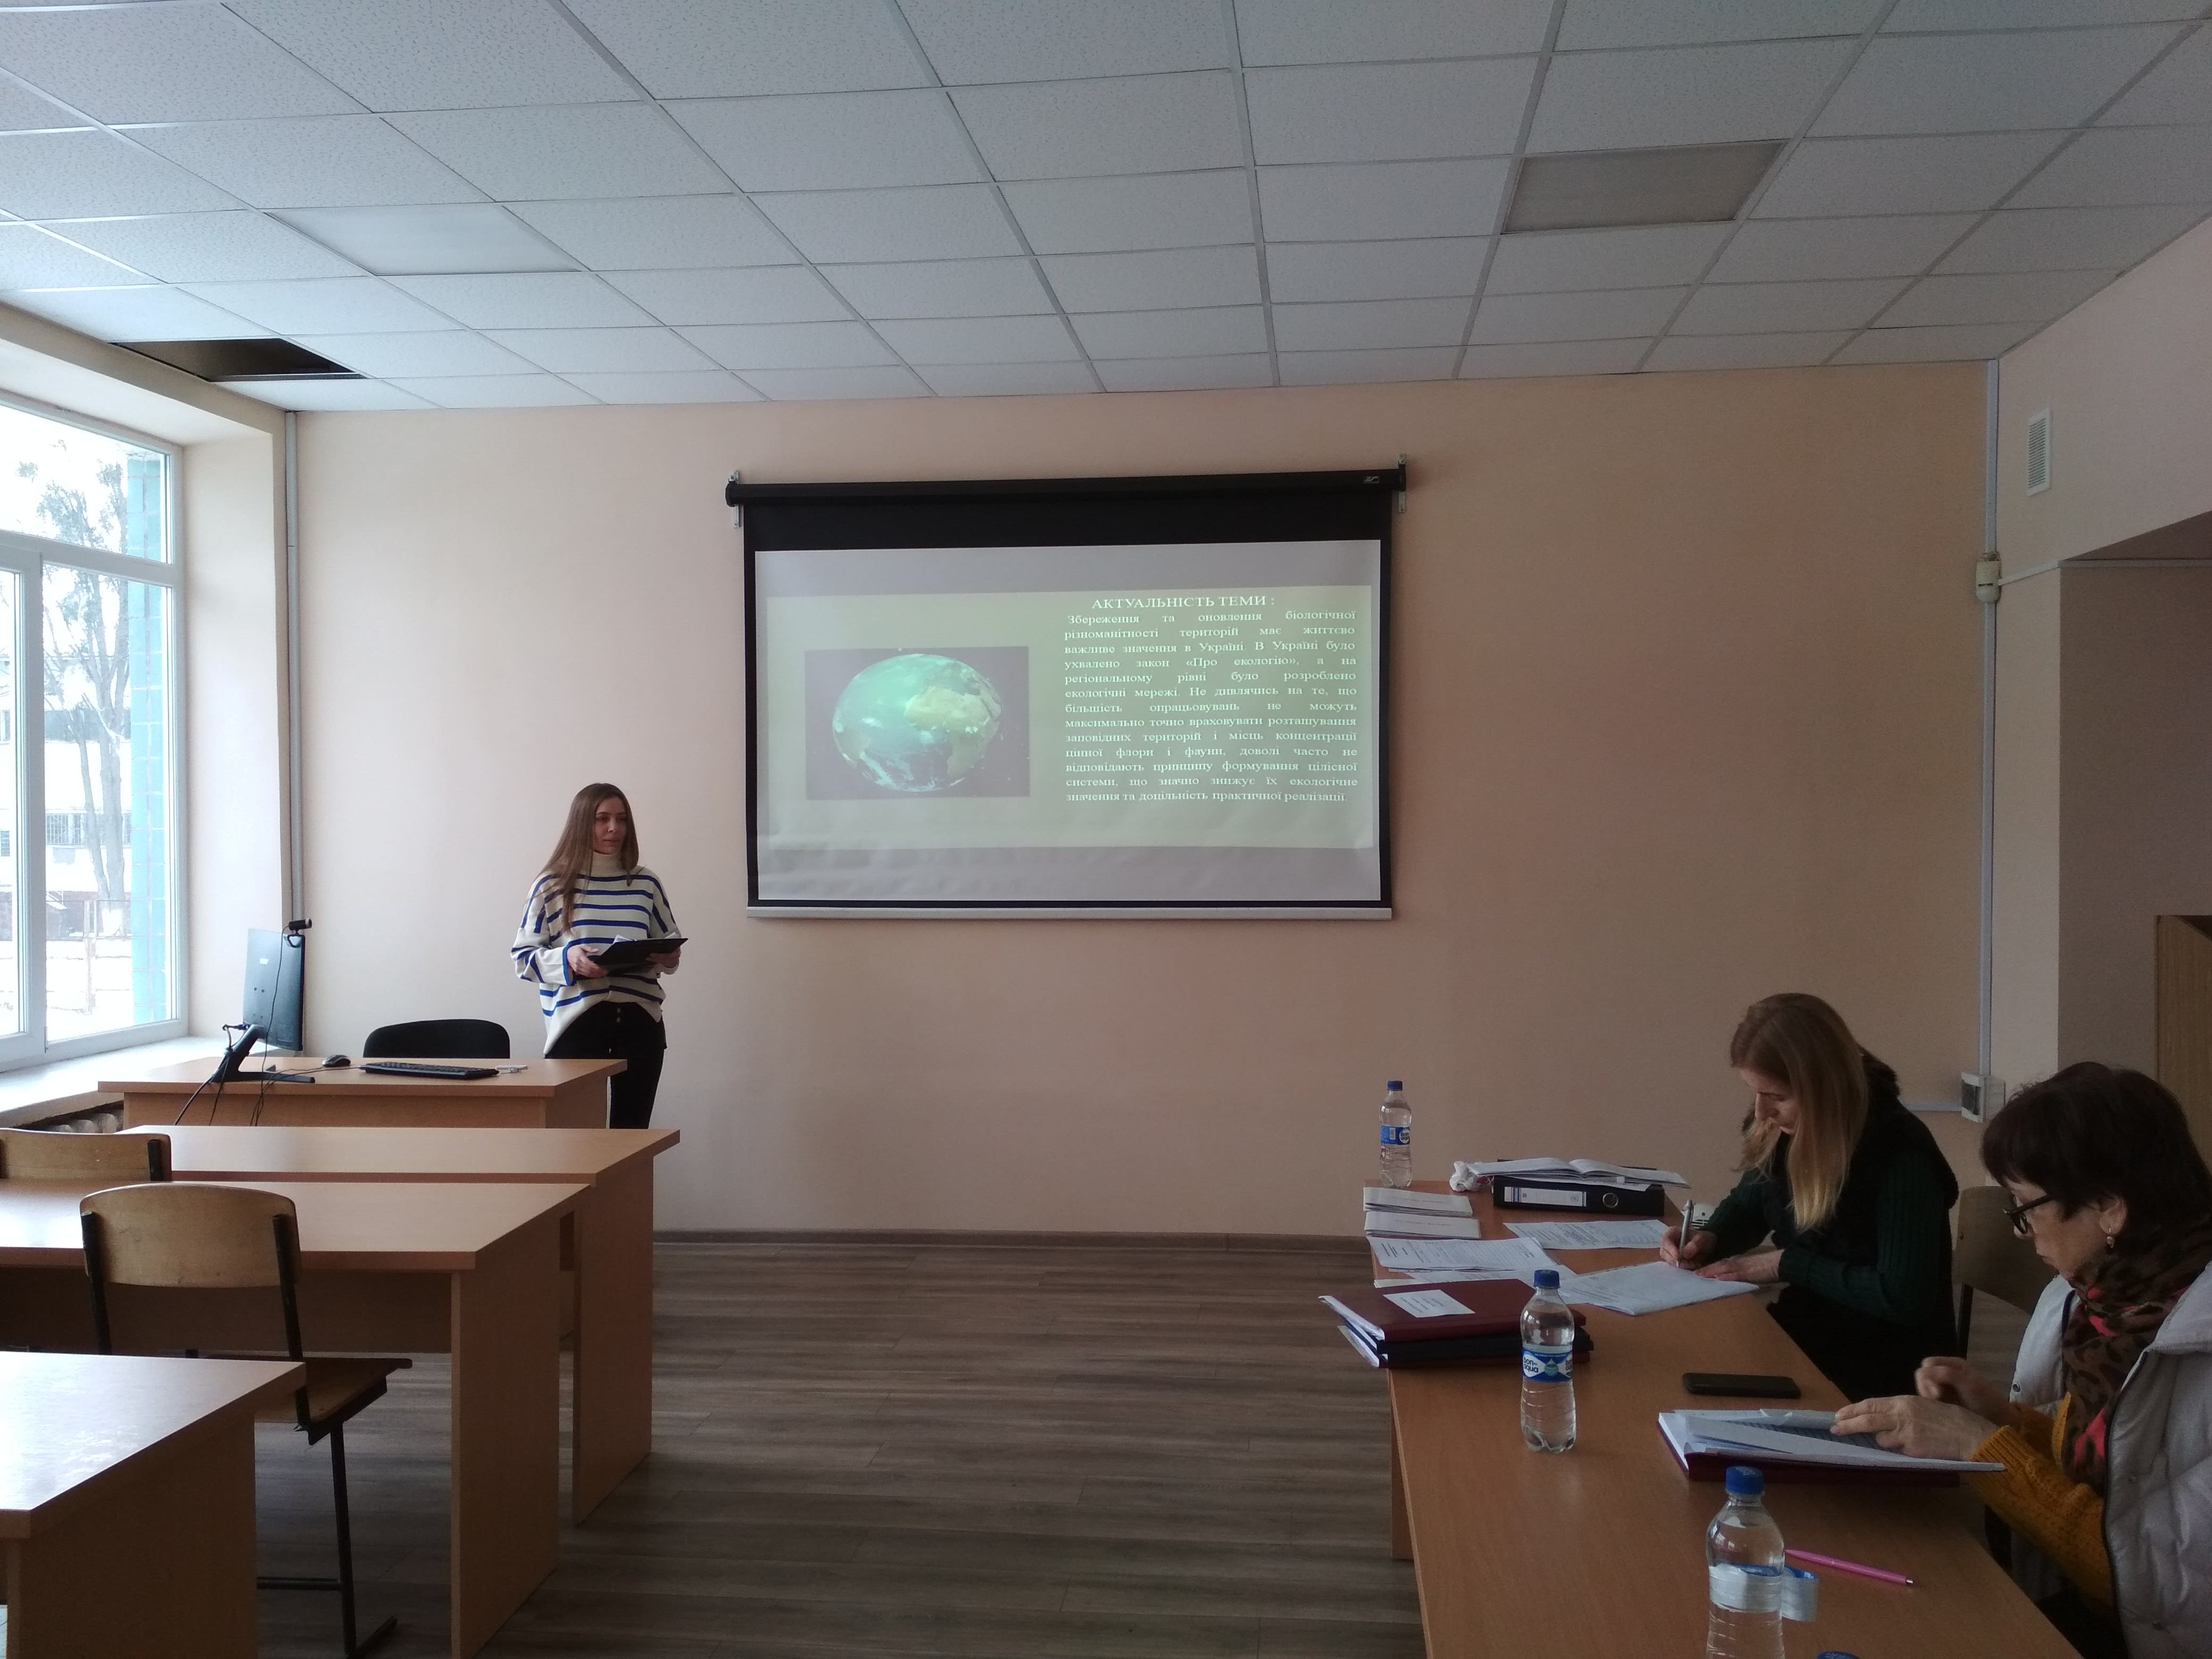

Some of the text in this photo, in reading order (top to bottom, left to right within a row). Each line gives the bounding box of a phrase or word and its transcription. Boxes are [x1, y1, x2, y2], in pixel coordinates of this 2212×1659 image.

[1092, 597, 1214, 608] АКТУАЛЬНІСТЬ
[1219, 596, 1266, 606] ТЕМИ
[1068, 615, 1139, 625] Збереження
[1285, 611, 1356, 619] біологічної
[1065, 629, 1159, 640] різноманітності
[1179, 628, 1238, 638] територій
[1255, 642, 1264, 650] В
[1273, 641, 1318, 651] Україні
[1326, 641, 1355, 651] було
[1065, 660, 1120, 670] ухвалено
[1186, 657, 1218, 668] «Про
[1065, 671, 1356, 685] регіональному рівні було розроблено
[1065, 689, 1126, 697] екологічні
[1215, 687, 1279, 696] дивлячись
[1065, 703, 1122, 713] більшість
[1150, 703, 1239, 714] опрацьовувань
[1310, 703, 1357, 712] можуть
[1189, 718, 1262, 727] враховувати
[1268, 718, 1356, 727] розташування
[1066, 731, 1357, 743] заповідних територій і місць концентрації
[1066, 748, 1102, 758] цінної
[1117, 748, 1153, 758] флори
[1168, 747, 1170, 756] і
[1240, 747, 1279, 756] доволі
[1066, 761, 1357, 773] відповідають принципу формування цілісної
[1211, 778, 1255, 786] знижує
[1290, 777, 1358, 786] екологічне
[1139, 791, 1208, 801] доцільність
[1212, 792, 1282, 801] практичної
